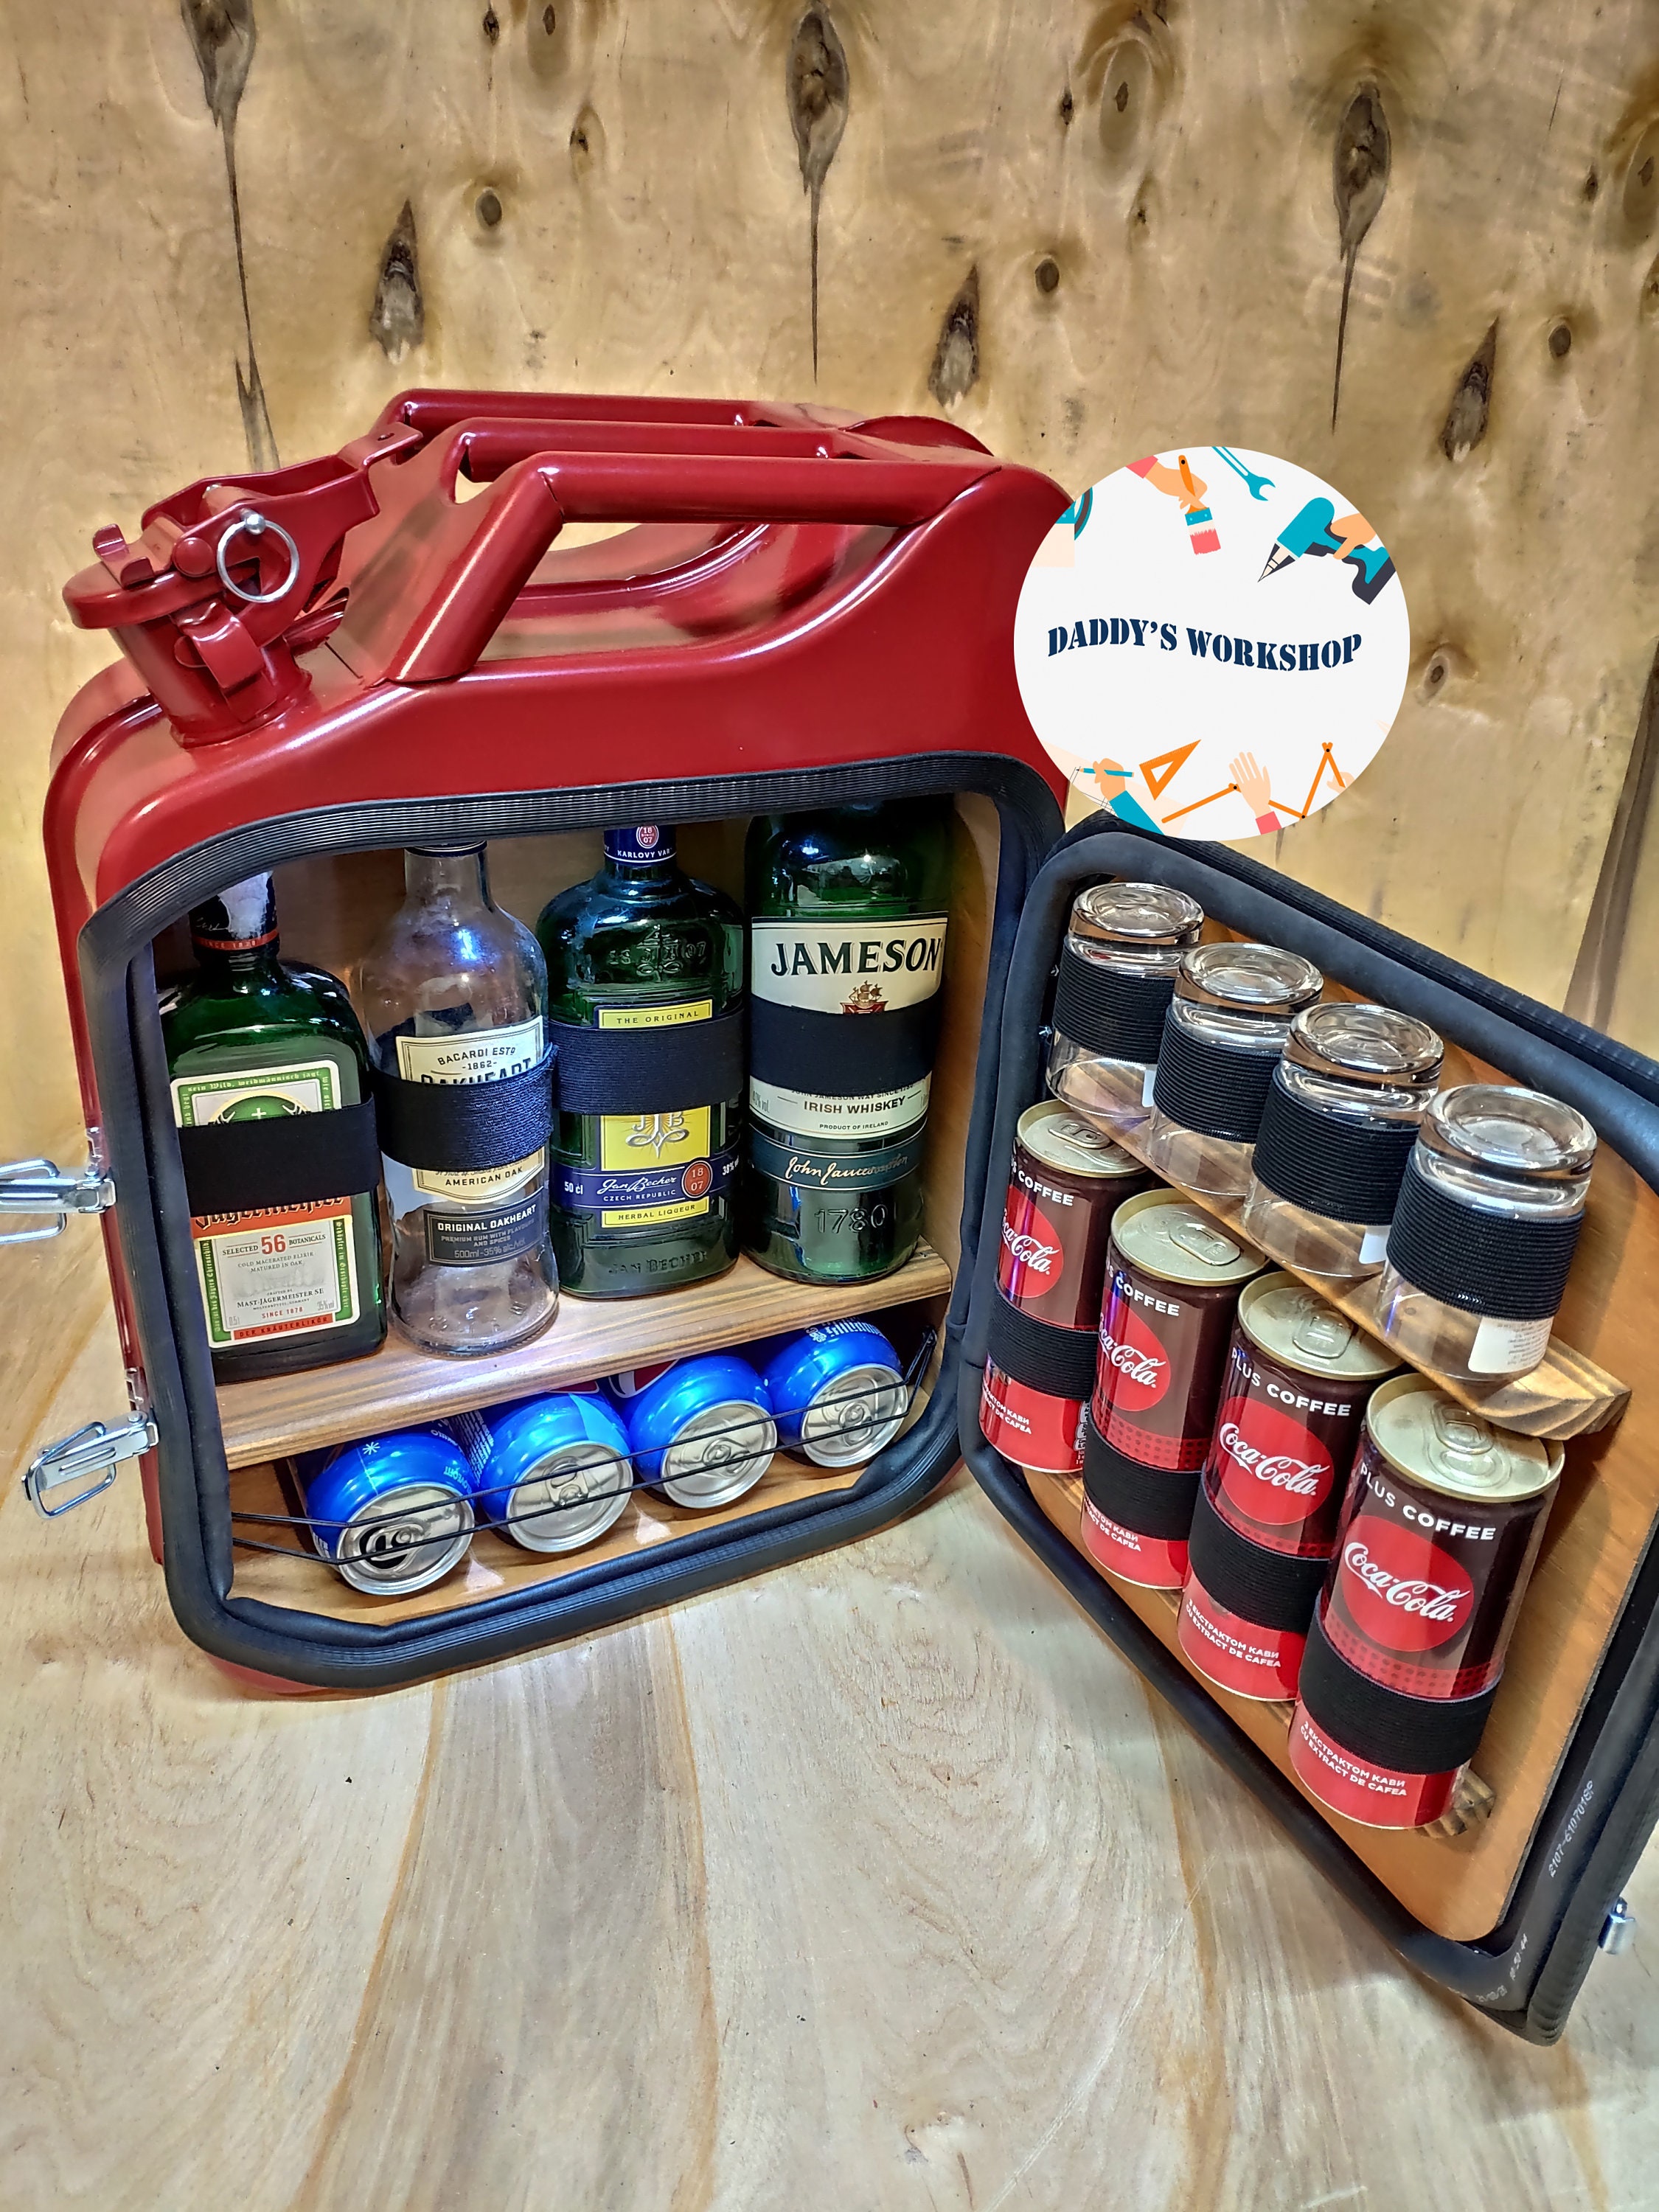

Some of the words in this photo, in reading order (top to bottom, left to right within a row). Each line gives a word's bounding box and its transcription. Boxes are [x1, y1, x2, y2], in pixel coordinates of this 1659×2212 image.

[617, 849, 655, 858] KARLOVY
[771, 937, 942, 976] JAMESON
[616, 1015, 639, 1024] THE
[645, 1010, 699, 1023] ORIGINAL
[437, 1048, 488, 1065] BACARDI
[804, 1101, 842, 1114] IRISH
[847, 1096, 906, 1114] WHISKEY
[445, 1173, 501, 1186] AMERICAN
[505, 1166, 523, 1178] OAK
[691, 1167, 704, 1178] 18
[785, 1157, 822, 1179] John
[565, 1181, 574, 1193] 50
[575, 1183, 583, 1194] cl
[597, 1178, 628, 1194] Jan
[628, 1176, 677, 1192] Becher
[691, 1181, 704, 1192] 07
[1018, 1170, 1074, 1206] COFFEE
[603, 1194, 632, 1202] CZECH
[636, 1189, 676, 1200] REPUBLIC
[437, 1222, 488, 1232] ORIGINAL
[490, 1203, 537, 1228] OAKHEART
[618, 1211, 655, 1220] HERBAL
[658, 1204, 695, 1216] LIQUEUR
[814, 1203, 888, 1234] 1780
[490, 1230, 506, 1238] WITH
[490, 1235, 511, 1245] SPICES
[223, 1245, 259, 1255] SELECTED
[261, 1234, 286, 1255] 56
[289, 1234, 326, 1245] BOTANICALS
[251, 1264, 280, 1273] MATURED
[256, 1255, 293, 1266] MACERATED
[237, 1291, 313, 1309] MAST-JÄGERMEISTER
[315, 1287, 324, 1295] SE
[1116, 1276, 1180, 1317] COFFEE
[262, 1310, 283, 1319] SINCE
[239, 1329, 256, 1338] DER
[260, 1316, 329, 1334] KRÄUTERLIKÖR
[1231, 1347, 1261, 1387] PLUS
[1267, 1383, 1352, 1416] COFFEE
[995, 1409, 1004, 1420] DE
[1005, 1416, 1032, 1434] CAFEA
[1006, 1409, 1029, 1425] КАВИ
[1219, 1422, 1330, 1495] Coca-Cola
[1360, 1462, 1397, 1507] PLUS
[1403, 1504, 1496, 1541] COFFEE
[1099, 1523, 1110, 1536] DE
[1110, 1532, 1141, 1552] CAFEA
[1113, 1525, 1138, 1543] КАВИ
[1344, 1541, 1471, 1623] Coca-Cola
[1192, 1615, 1228, 1650] EXTRACT
[1228, 1646, 1243, 1658] DE
[1245, 1654, 1281, 1668] CAFEA
[1248, 1646, 1279, 1659] КАВИ
[1301, 1725, 1309, 1741] CU
[1309, 1739, 1349, 1777] EXTRACT
[1349, 1774, 1366, 1787] DE
[1368, 1782, 1408, 1796] CAFEA
[1309, 1728, 1370, 1779] ЕКСТРАКТОМ
[1371, 1774, 1405, 1787] КАВИ
